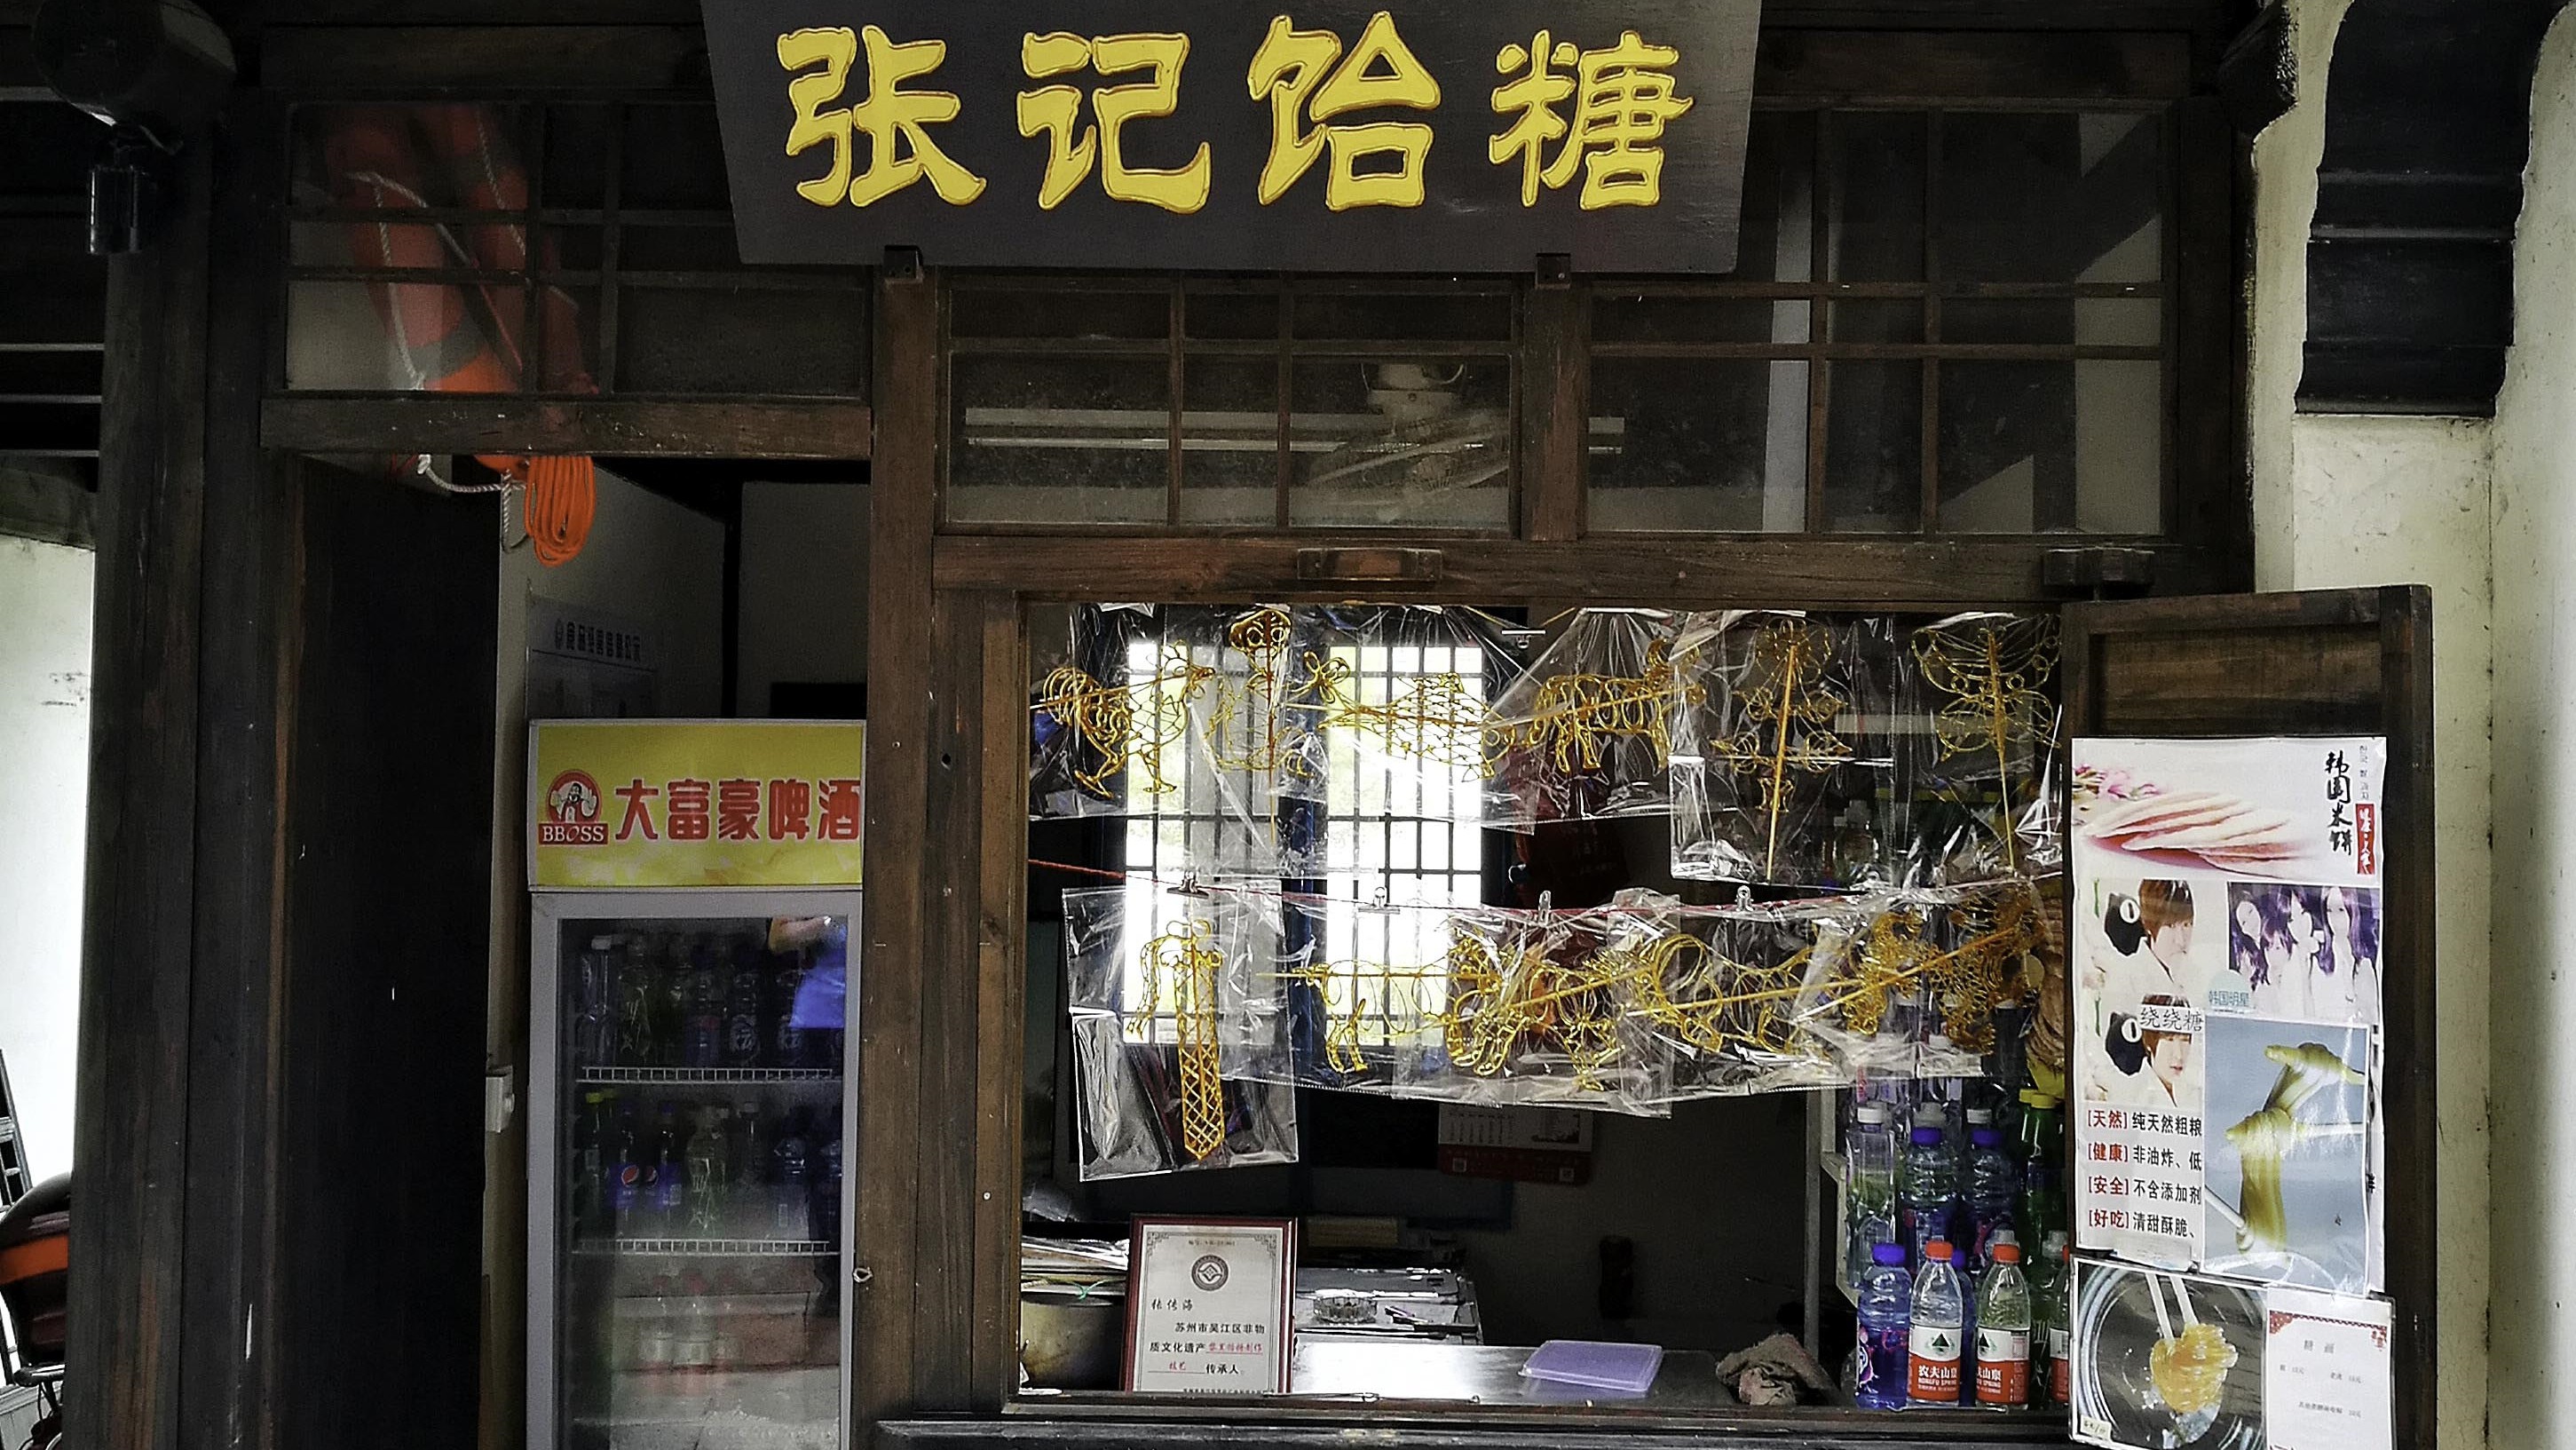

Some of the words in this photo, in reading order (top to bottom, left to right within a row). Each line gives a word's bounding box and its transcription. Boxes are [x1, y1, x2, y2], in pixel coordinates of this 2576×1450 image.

[777, 10, 1695, 213] 张记饴糖
[614, 778, 860, 841] 大富豪啤酒
[541, 825, 604, 843] BBOSS
[2140, 1006, 2203, 1032] 绕绕糖
[2131, 1113, 2202, 1137] 纯天然粗粮
[1174, 1322, 1265, 1335] 苏州市吴江区非物
[1149, 1342, 1205, 1353] 质文化遗产
